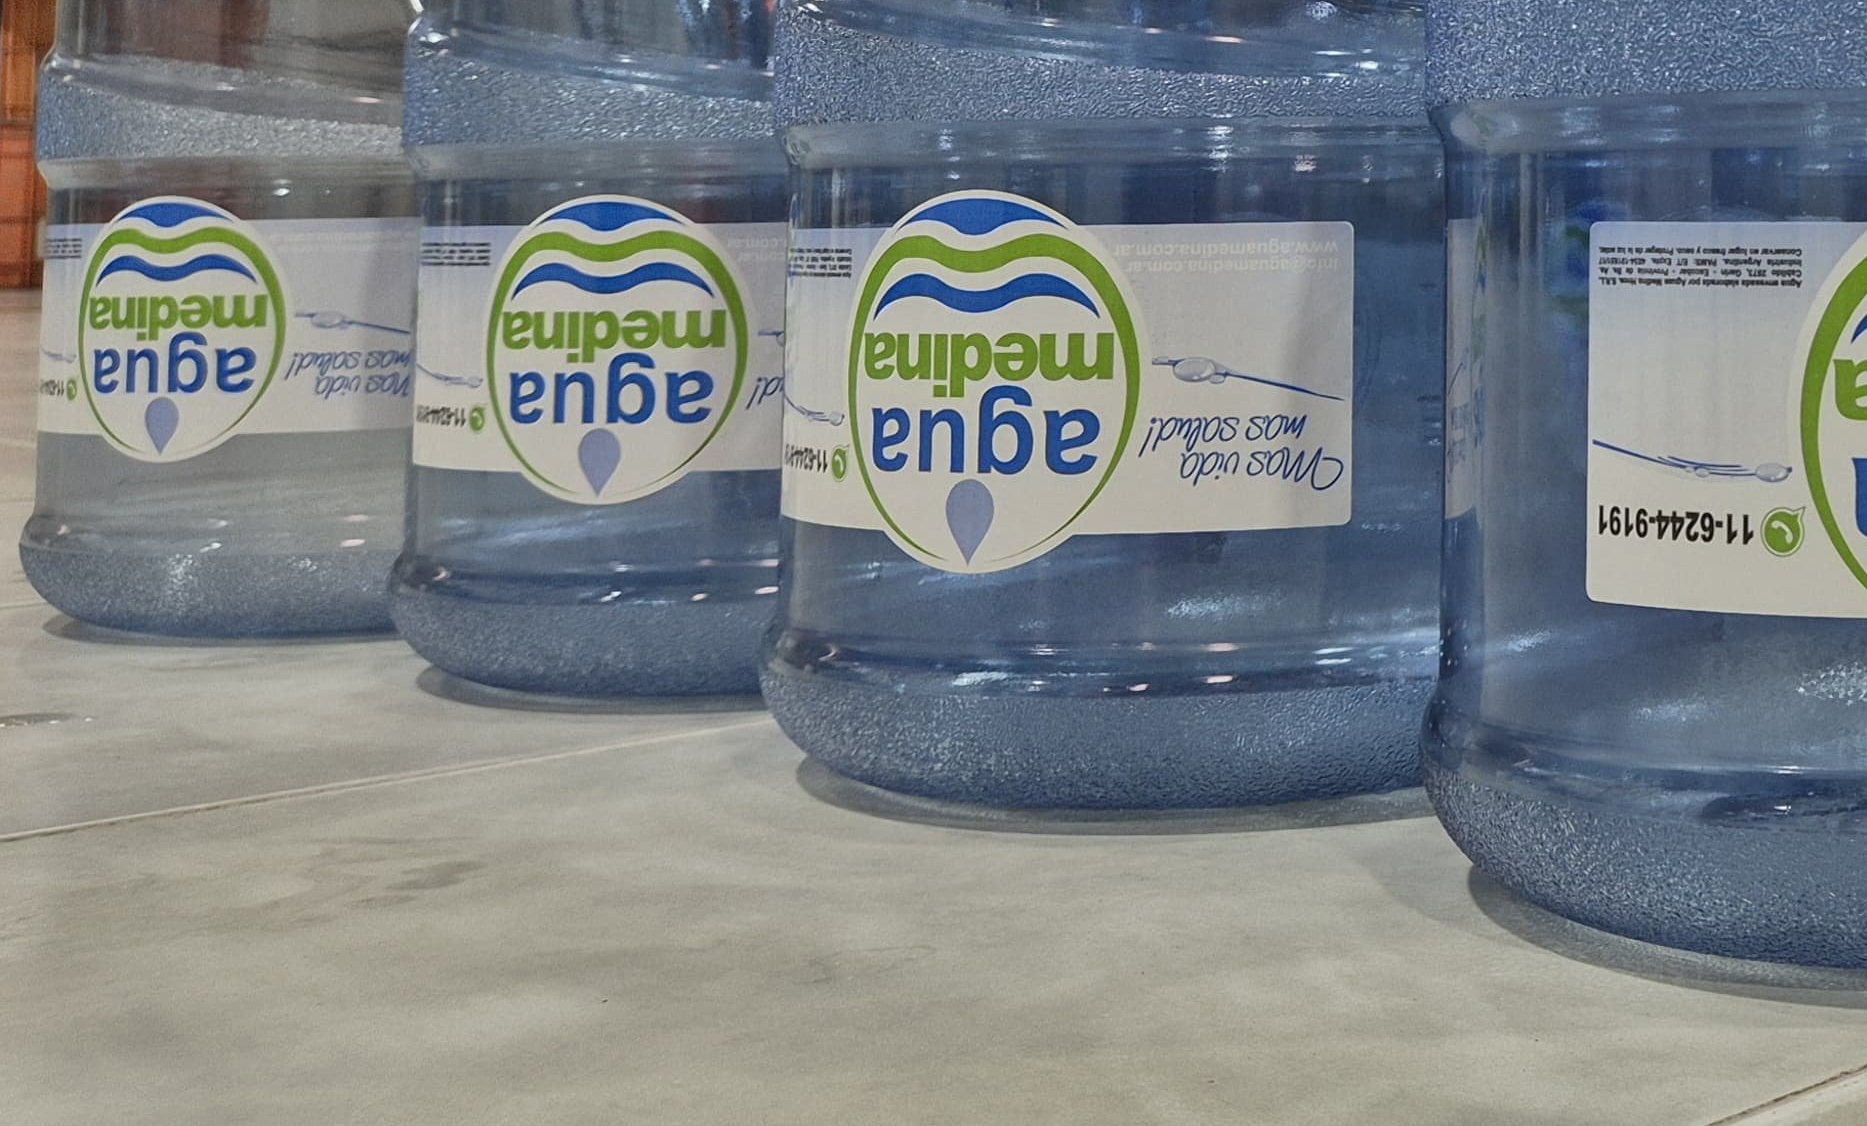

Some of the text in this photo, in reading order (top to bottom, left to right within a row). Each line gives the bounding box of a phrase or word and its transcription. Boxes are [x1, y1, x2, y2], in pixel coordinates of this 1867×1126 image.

[89, 295, 269, 342] medina
[501, 310, 728, 364] medina
[93, 331, 257, 395] agua
[315, 375, 361, 400] vida
[863, 332, 1115, 398] medina
[509, 352, 715, 425] agua
[871, 385, 1101, 476] agua
[1138, 414, 1307, 458] mas salud!
[1180, 447, 1344, 490] Mas vida
[1598, 505, 1754, 545] 11-6244-9191
